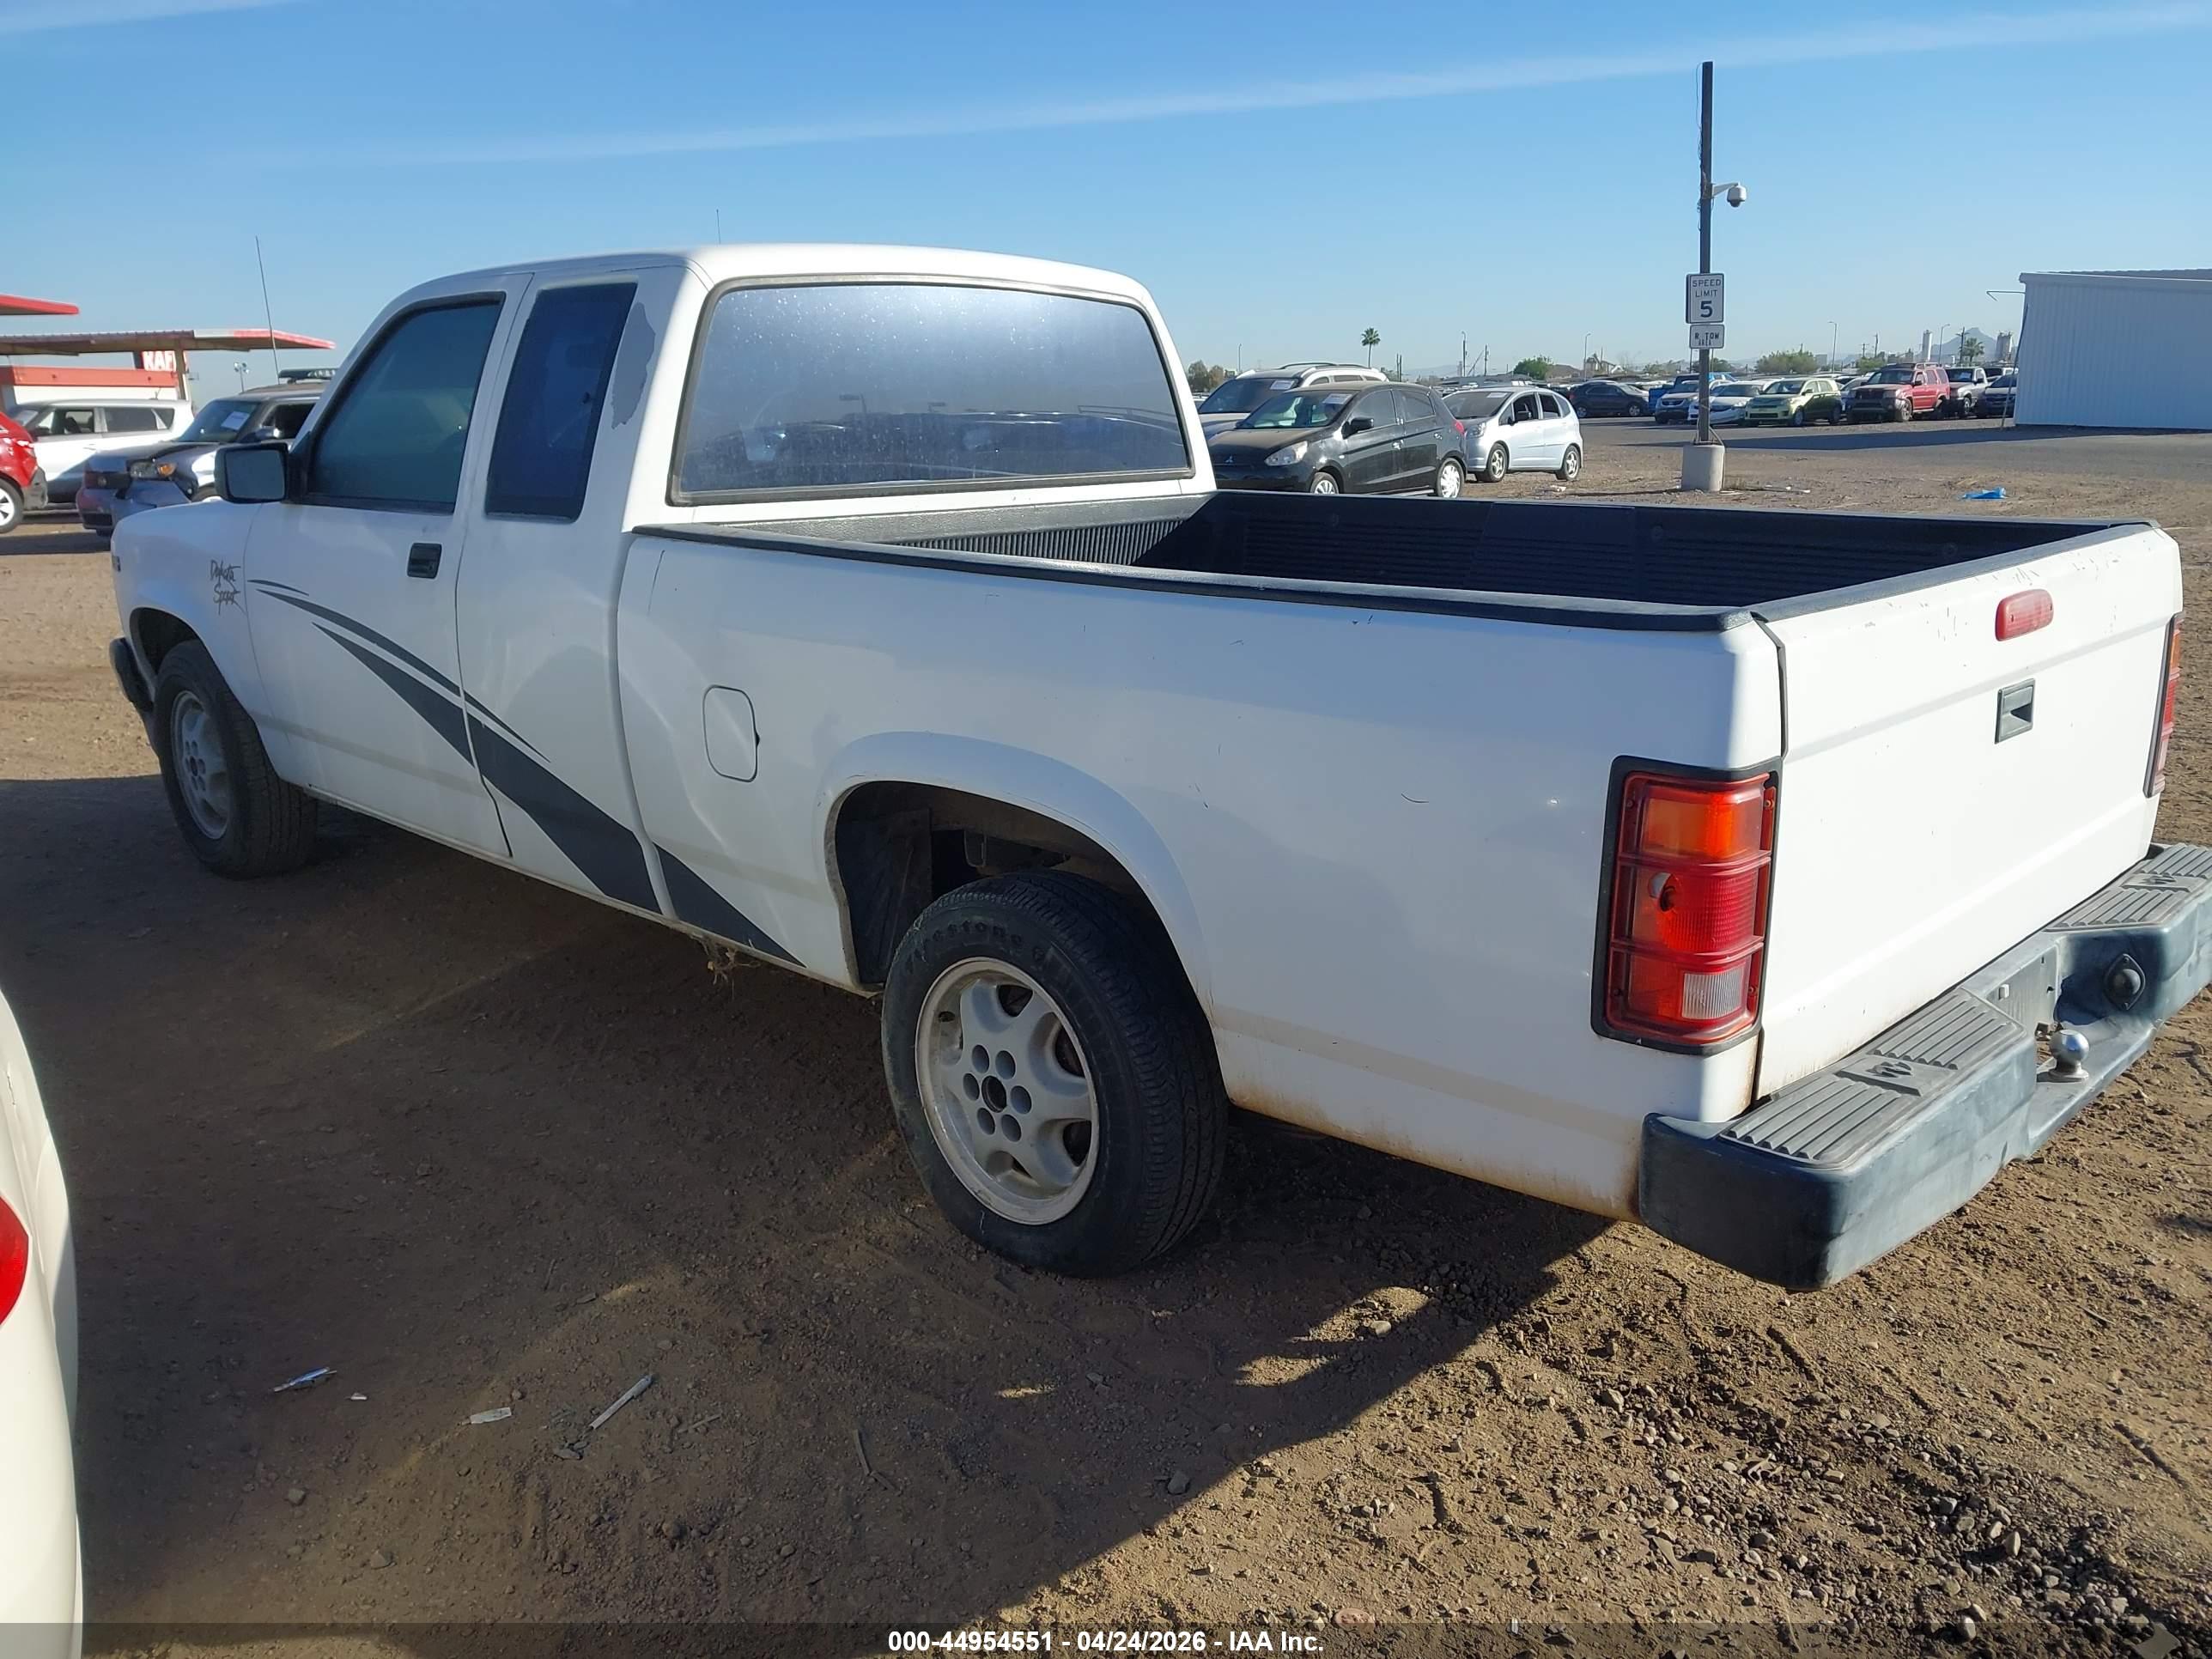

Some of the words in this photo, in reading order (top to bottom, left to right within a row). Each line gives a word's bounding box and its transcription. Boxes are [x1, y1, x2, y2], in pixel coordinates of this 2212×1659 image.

[1692, 278, 1722, 288] SPEED
[1695, 289, 1718, 298] LIMIT
[1700, 300, 1713, 318] 5
